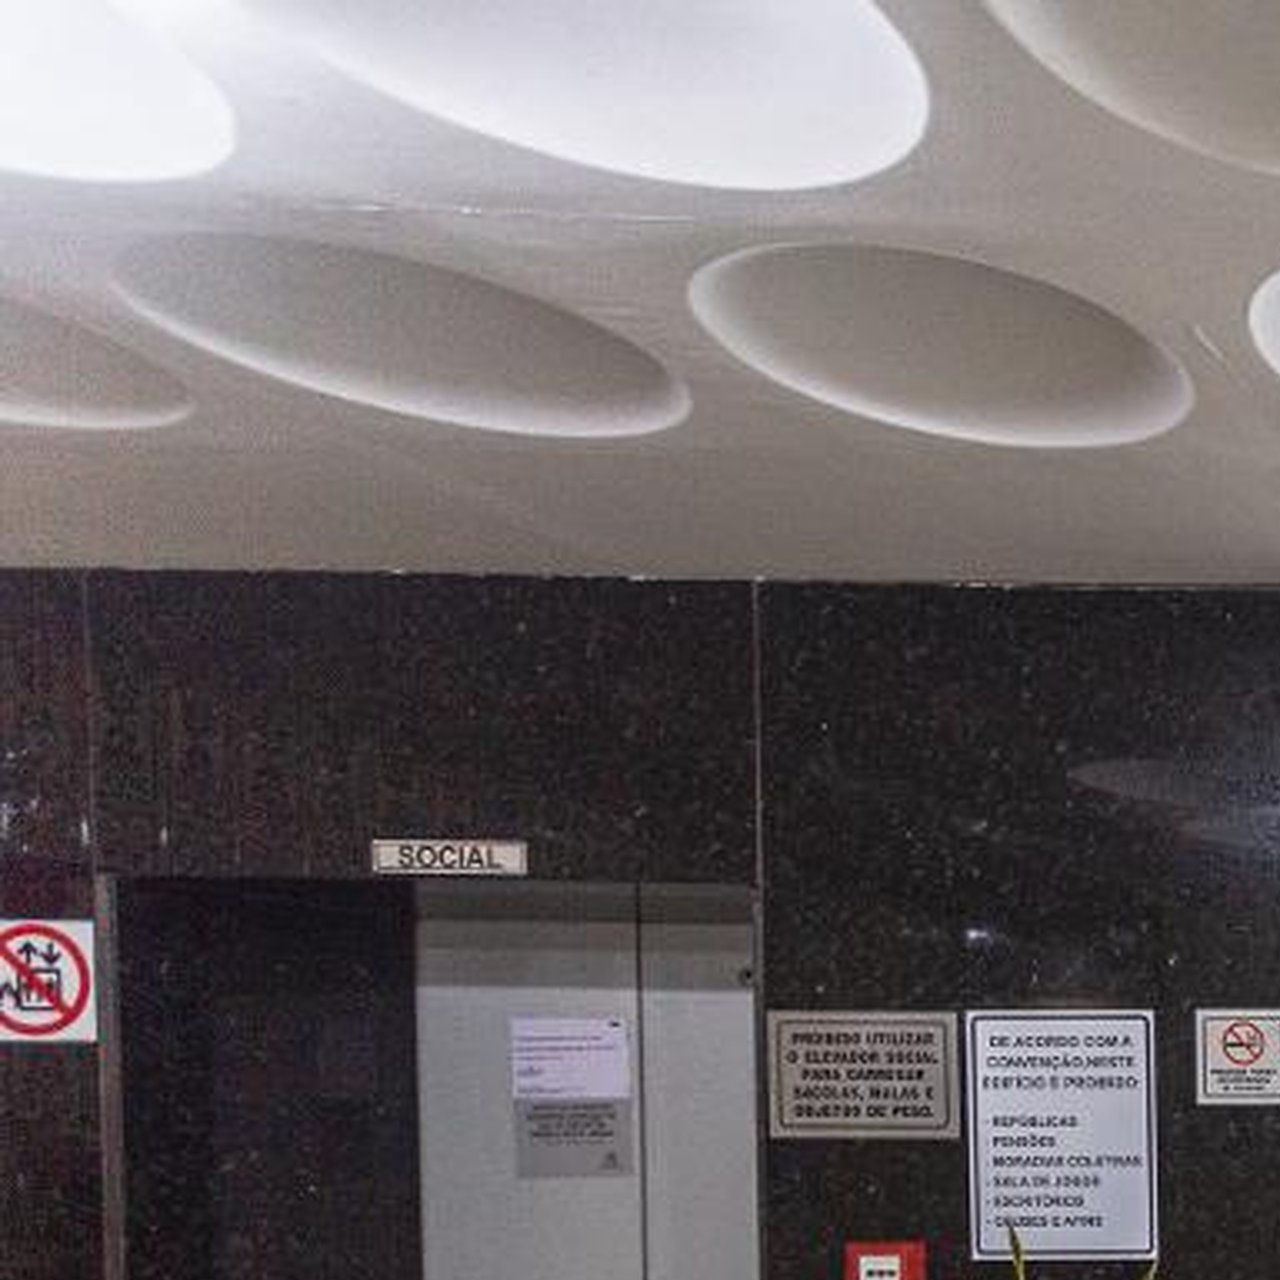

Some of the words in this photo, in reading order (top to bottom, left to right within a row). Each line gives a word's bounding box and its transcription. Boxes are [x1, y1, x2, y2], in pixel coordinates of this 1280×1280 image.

[399, 845, 502, 869] SOCIAL
[792, 1031, 860, 1045] PROIBIDO
[866, 1031, 935, 1045] UTILIZAR
[989, 1036, 1010, 1048] DE
[1013, 1036, 1080, 1048] ACORDO
[1084, 1036, 1118, 1048] COM
[1121, 1036, 1134, 1048] A
[785, 1050, 798, 1064] O
[805, 1050, 881, 1064] ELEVADOR
[801, 1068, 842, 1080] PARA
[925, 1086, 935, 1100] E
[866, 1105, 888, 1118] DE
[993, 1176, 1031, 1188] SALA
[1031, 1176, 1050, 1188] DE
